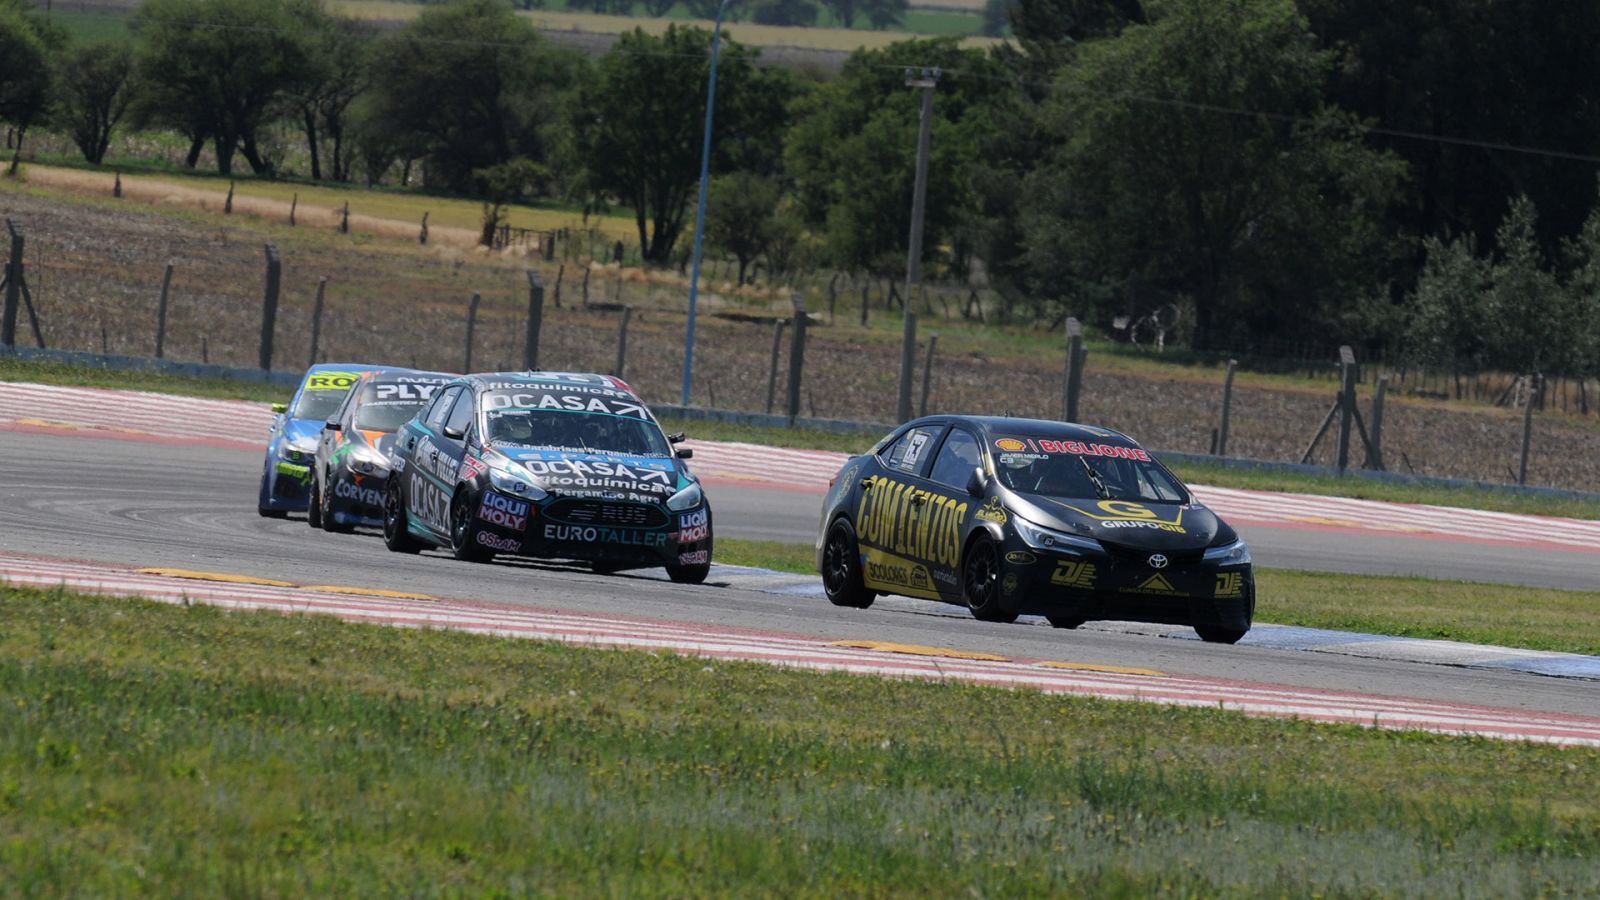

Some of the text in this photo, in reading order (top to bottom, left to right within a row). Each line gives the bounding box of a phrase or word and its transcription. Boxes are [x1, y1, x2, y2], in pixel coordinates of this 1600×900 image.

[311, 377, 357, 387] RO
[377, 385, 440, 399] PLY
[489, 393, 611, 413] OCASA
[1039, 440, 1152, 462] BIGLIONE
[526, 460, 639, 480] OCASA
[411, 473, 441, 527] OCASA
[484, 492, 526, 516] LIQUI
[555, 487, 660, 504] Pergamio Agro
[479, 505, 525, 529] MOLY
[1102, 520, 1186, 534] GRUPOGIB
[477, 531, 522, 552] OSRAM
[544, 525, 667, 546] EUROTALLER
